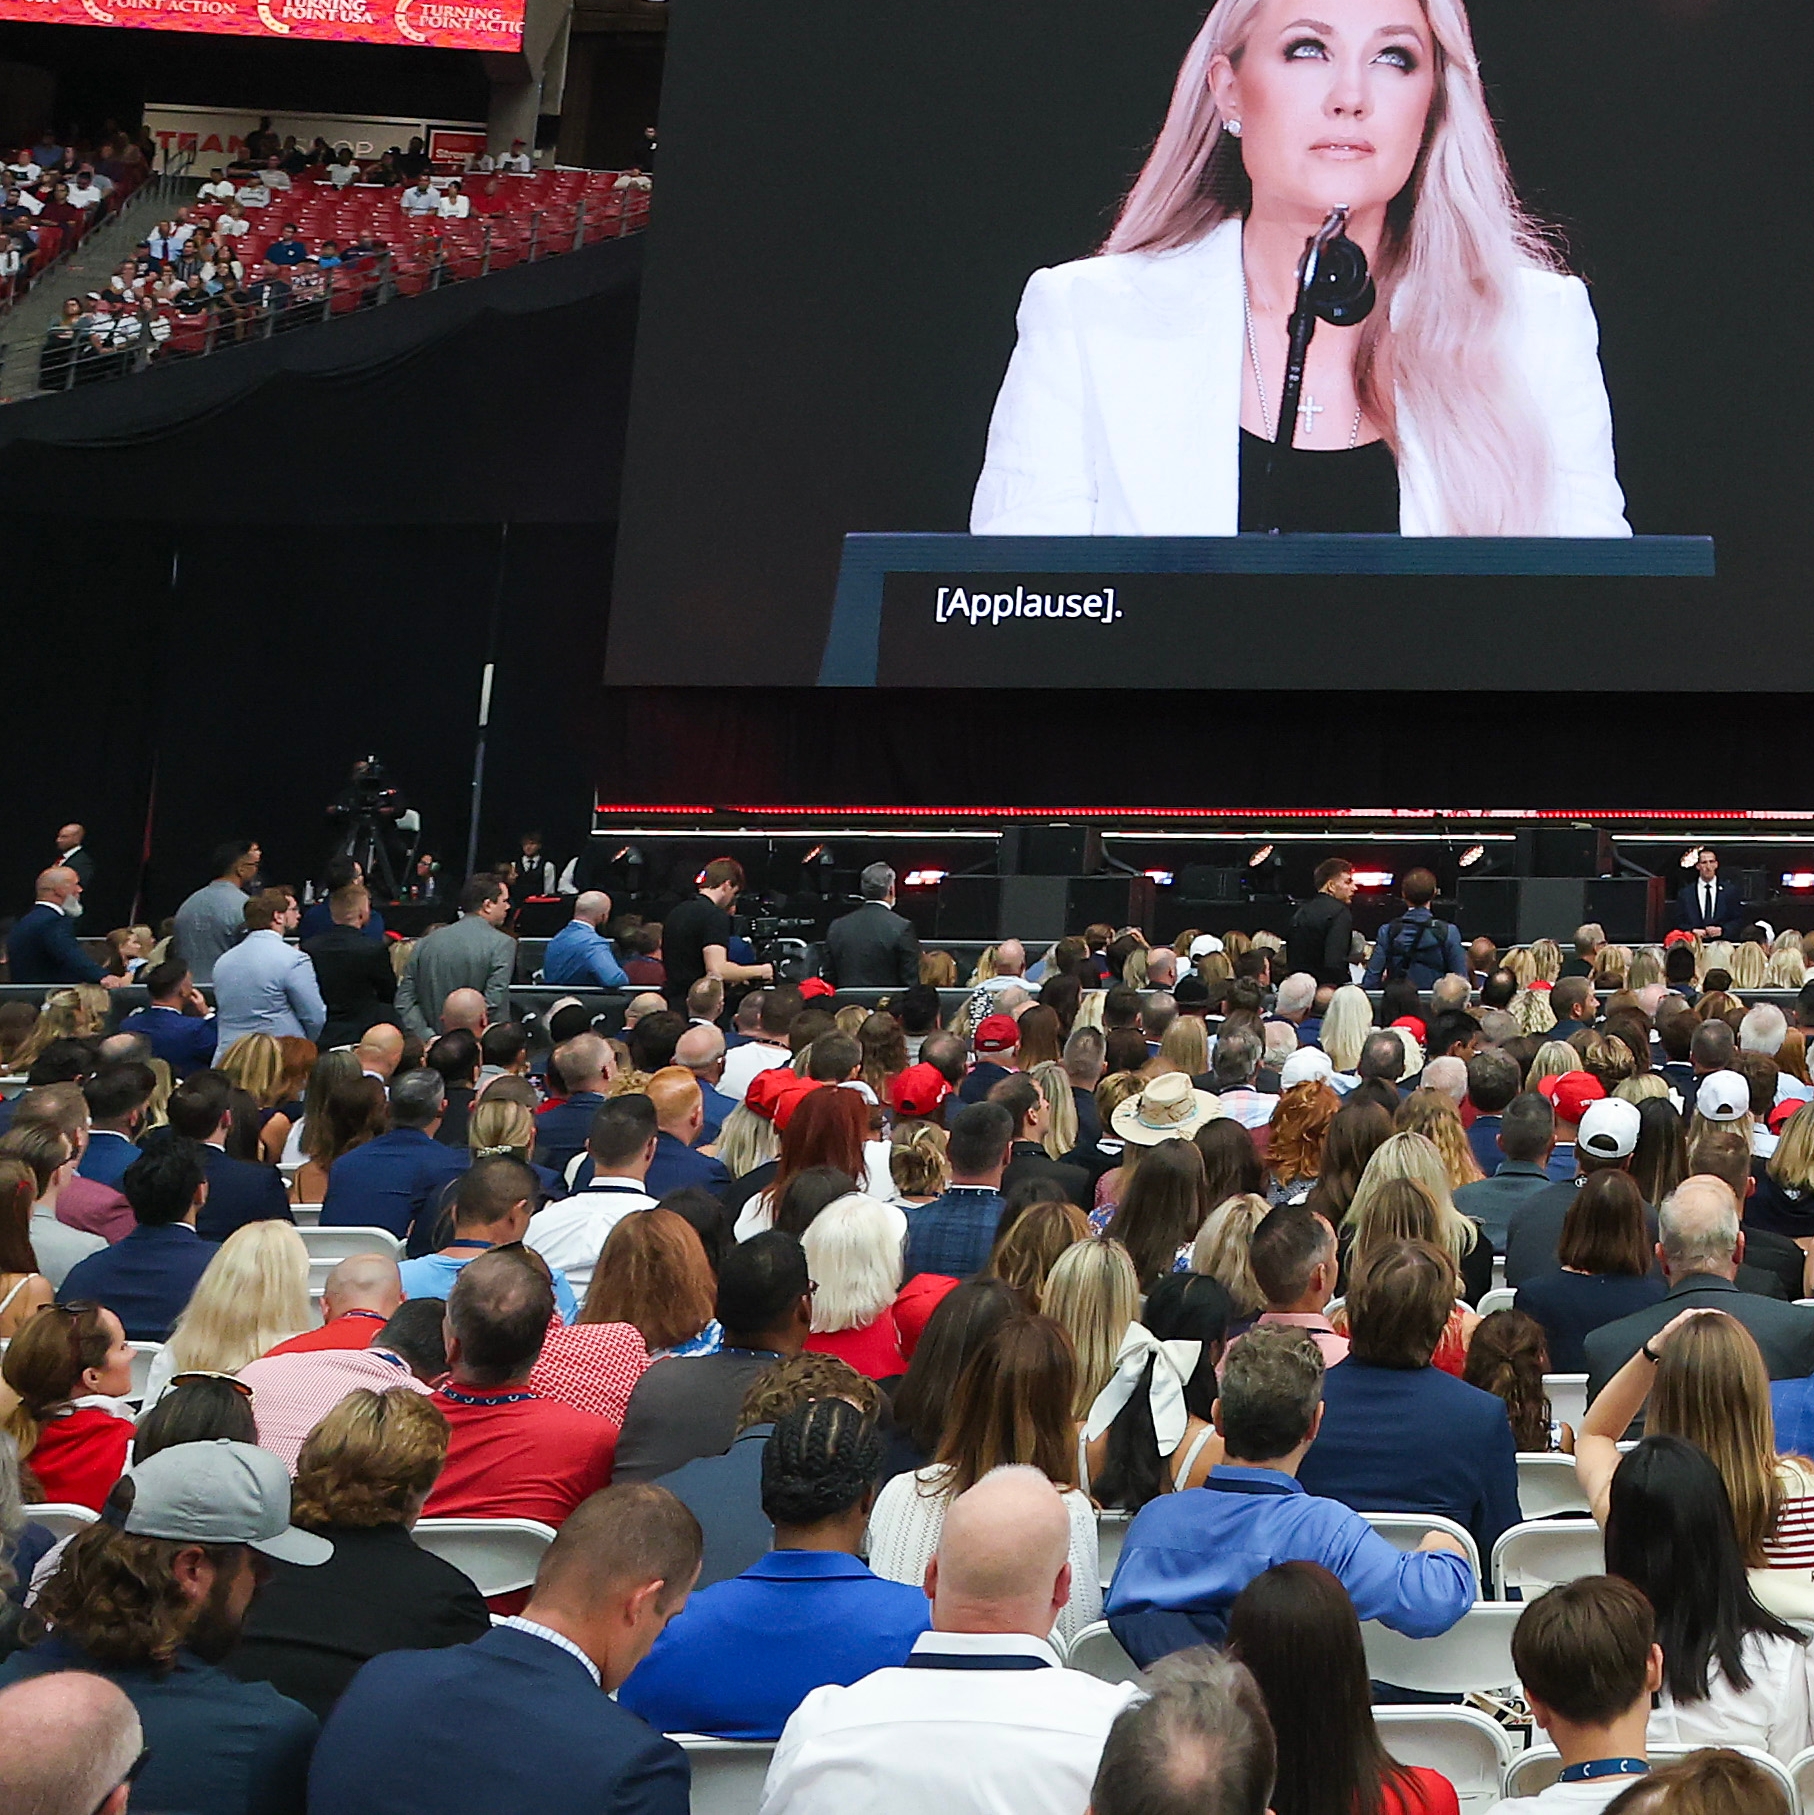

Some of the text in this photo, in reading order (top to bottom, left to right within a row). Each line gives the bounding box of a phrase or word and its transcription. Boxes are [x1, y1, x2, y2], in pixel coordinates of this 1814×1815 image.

[282, 6, 374, 25] POINT USA
[420, 3, 502, 21] TURNING
[419, 14, 477, 30] POINT
[935, 586, 1123, 626] [Applause].
